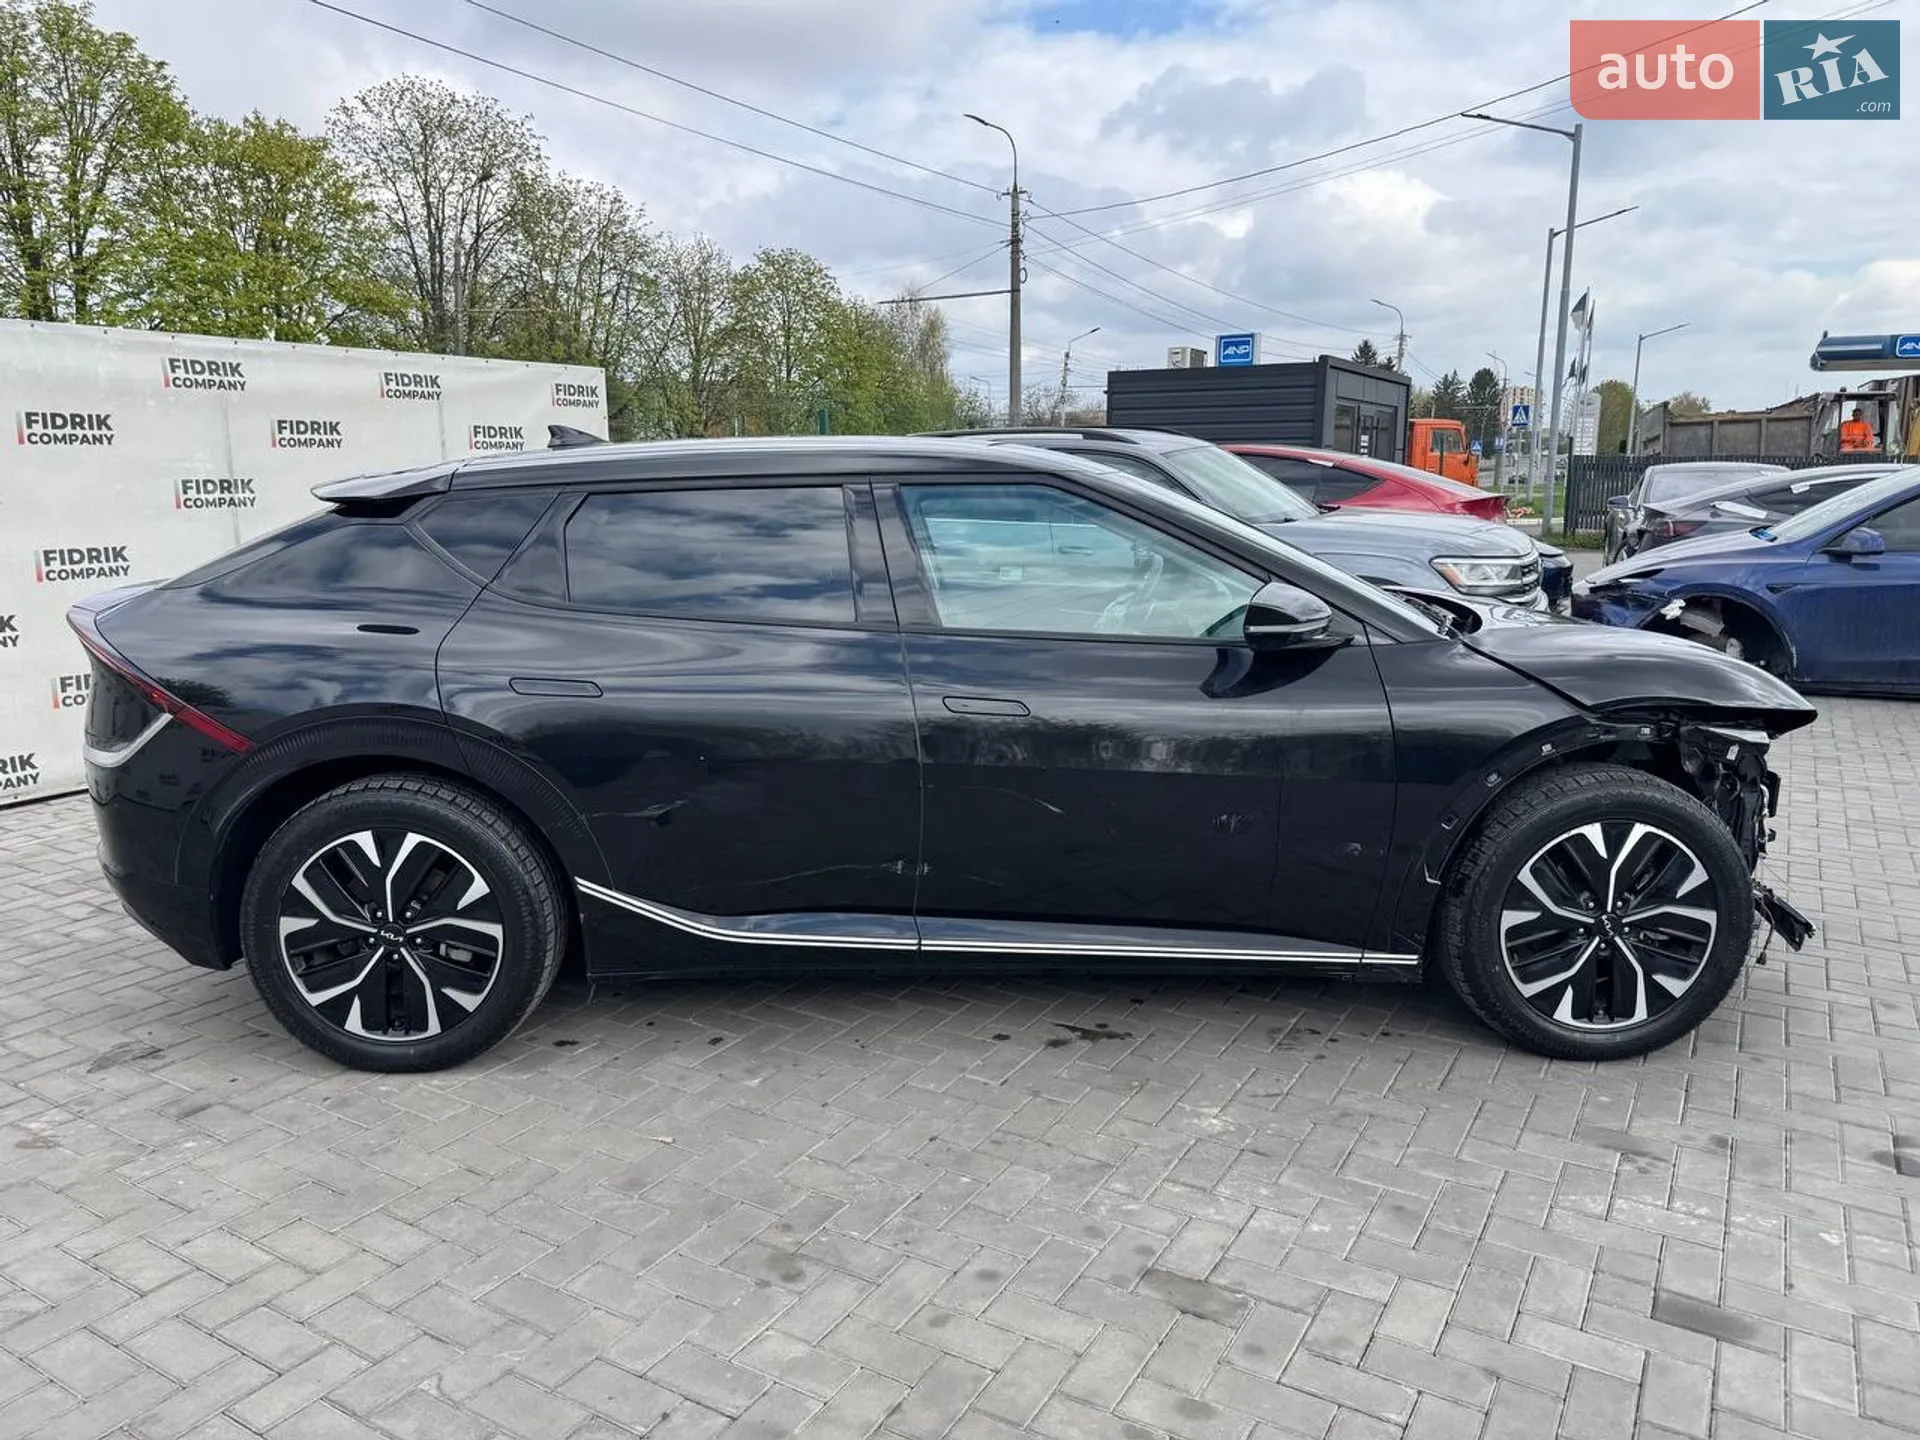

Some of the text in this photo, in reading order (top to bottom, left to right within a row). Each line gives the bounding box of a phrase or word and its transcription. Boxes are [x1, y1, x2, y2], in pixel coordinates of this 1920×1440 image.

[168, 357, 247, 380] FIDRIK
[171, 376, 248, 391] COMPANY
[384, 372, 441, 390] FIDRIK
[385, 388, 443, 401] COMPANY
[554, 383, 600, 399] FIDRIK
[556, 397, 600, 409] COMPANY
[24, 411, 113, 432] FIDRIK
[277, 419, 343, 437] FIDRIK
[26, 431, 115, 446] COMPANY
[472, 425, 525, 440] FIDRIK
[278, 436, 344, 450] COMPANY
[473, 439, 526, 451] COMPANY
[181, 478, 256, 495] FIDRIK
[182, 495, 257, 509] COMPANY
[43, 546, 130, 568] FIDRIK
[45, 564, 131, 583] COMPANY
